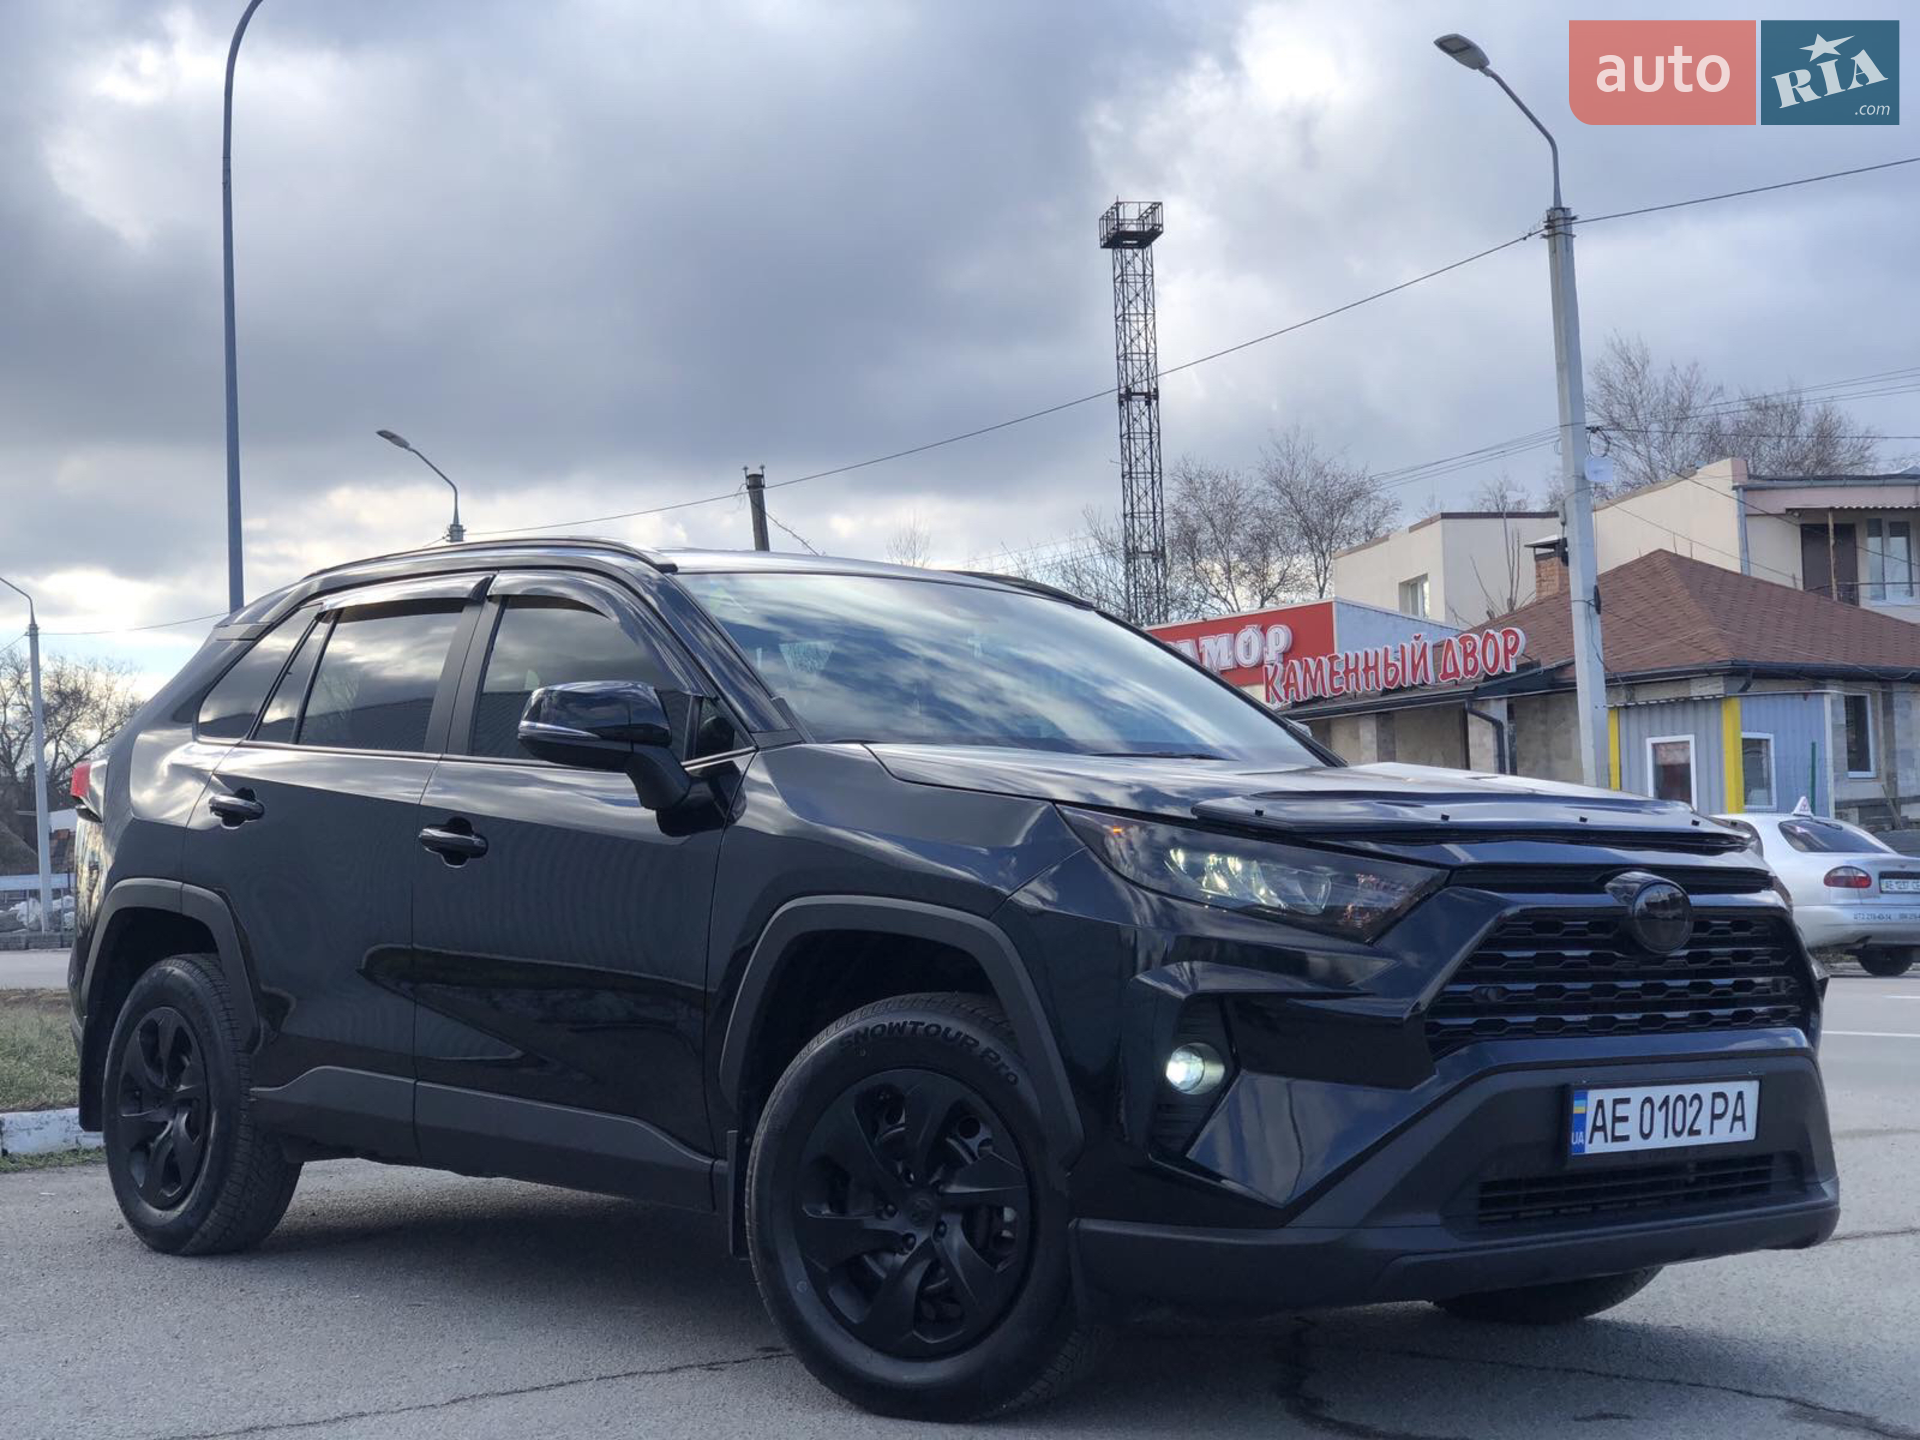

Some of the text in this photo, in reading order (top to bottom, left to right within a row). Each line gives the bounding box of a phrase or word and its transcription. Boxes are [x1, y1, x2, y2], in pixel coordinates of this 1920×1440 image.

[1262, 626, 1527, 704] КАМЕННЫЙ ДВОР
[1571, 1131, 1585, 1146] UA
[1588, 1090, 1747, 1145] AE 0102 PA
